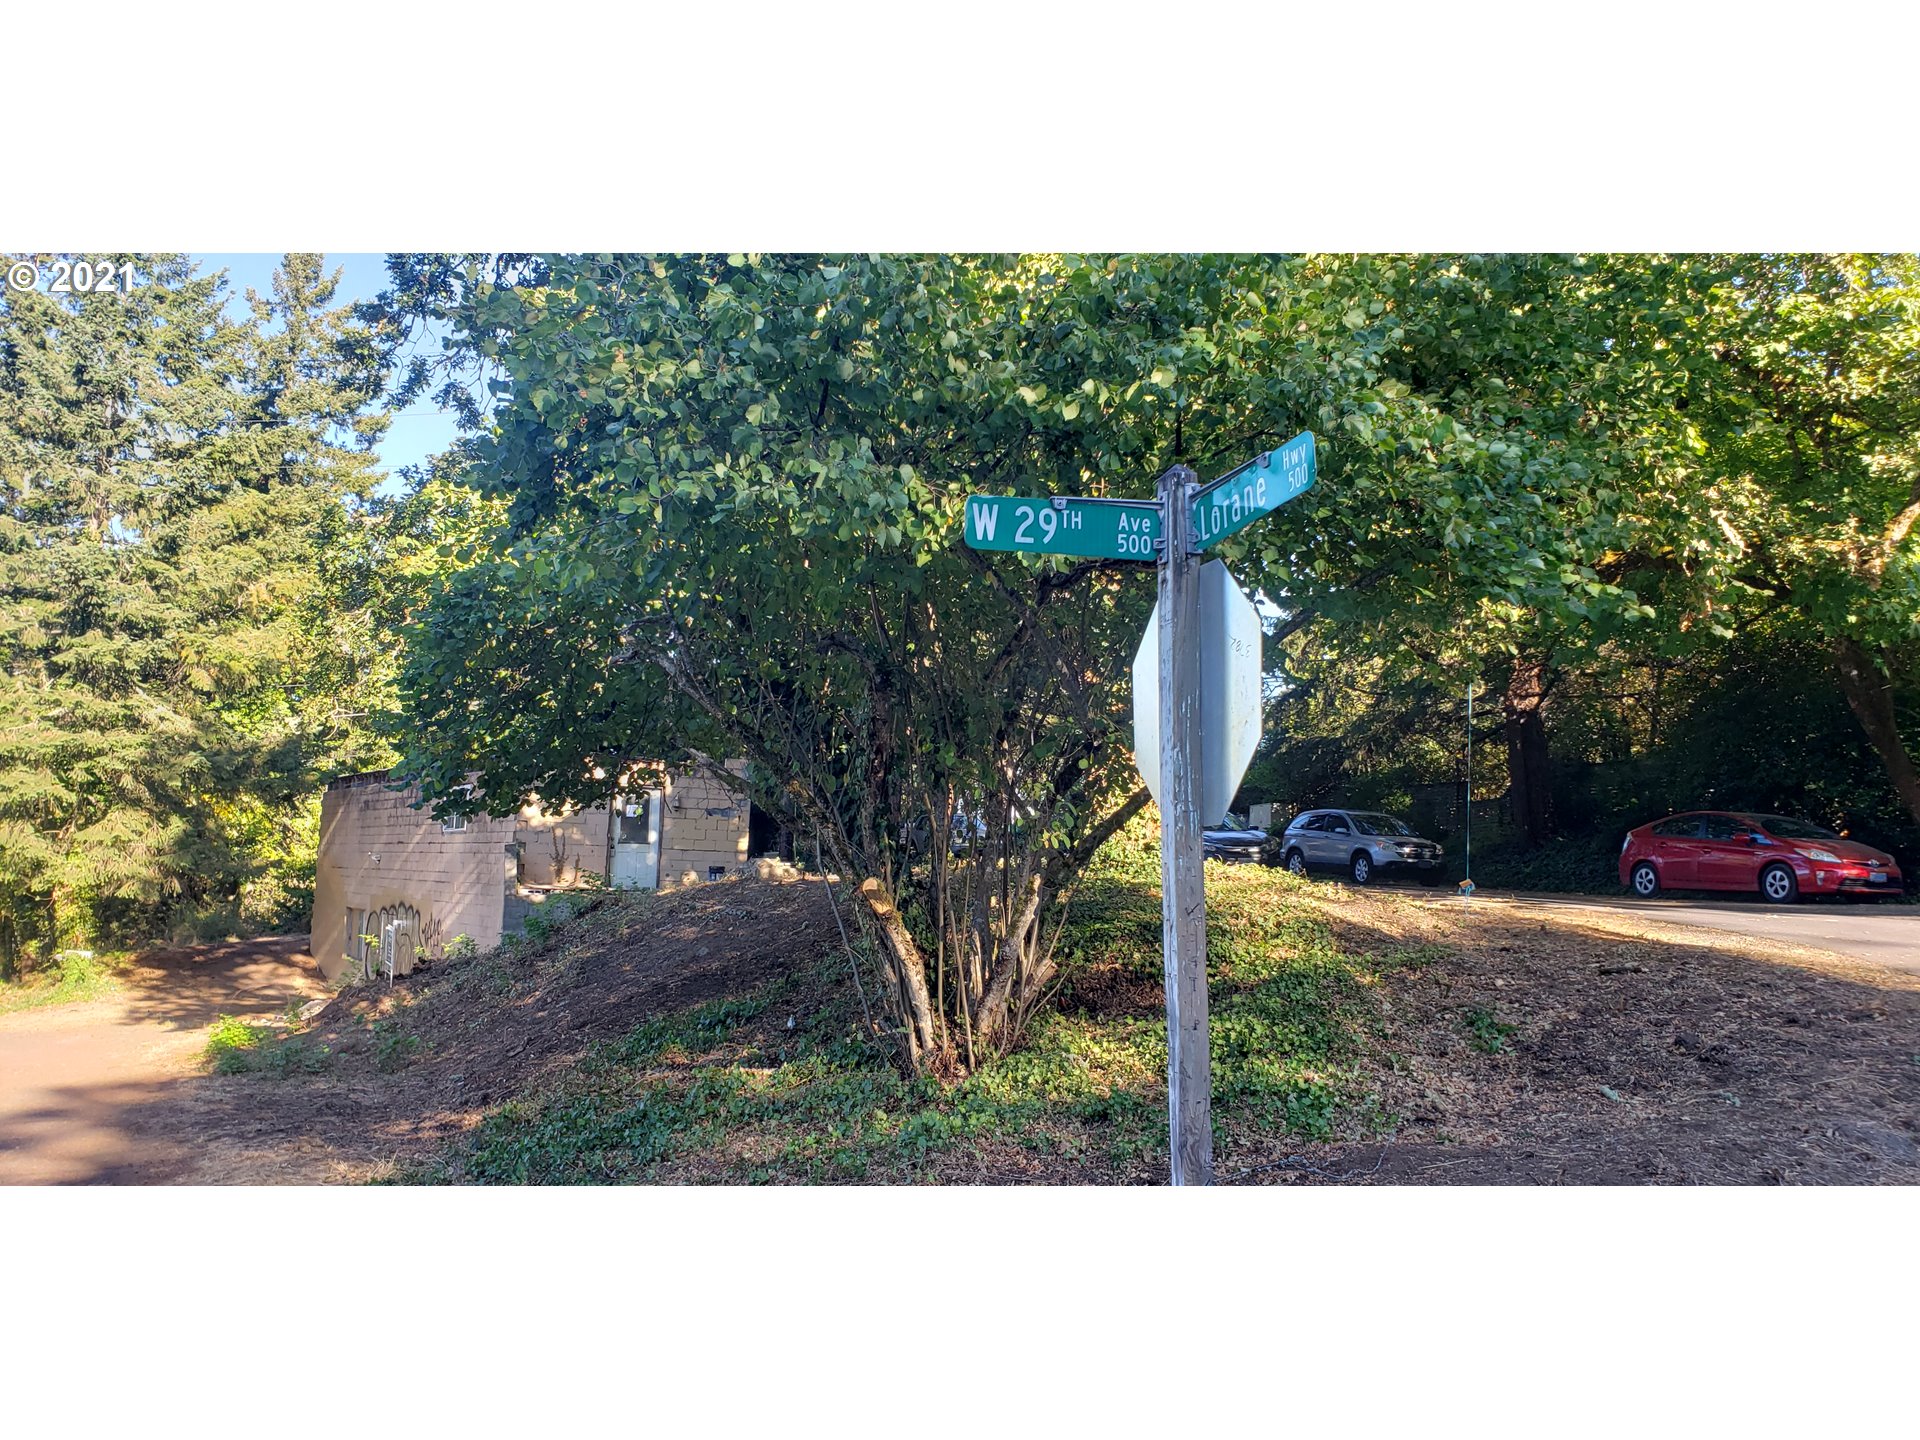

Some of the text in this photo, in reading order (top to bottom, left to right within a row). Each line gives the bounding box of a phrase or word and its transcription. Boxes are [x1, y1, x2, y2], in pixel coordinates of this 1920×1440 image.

[1288, 463, 1309, 493] 500
[972, 503, 1151, 544] W 29TH Ave
[1200, 477, 1267, 541] Lorane
[1117, 533, 1151, 554] 500
